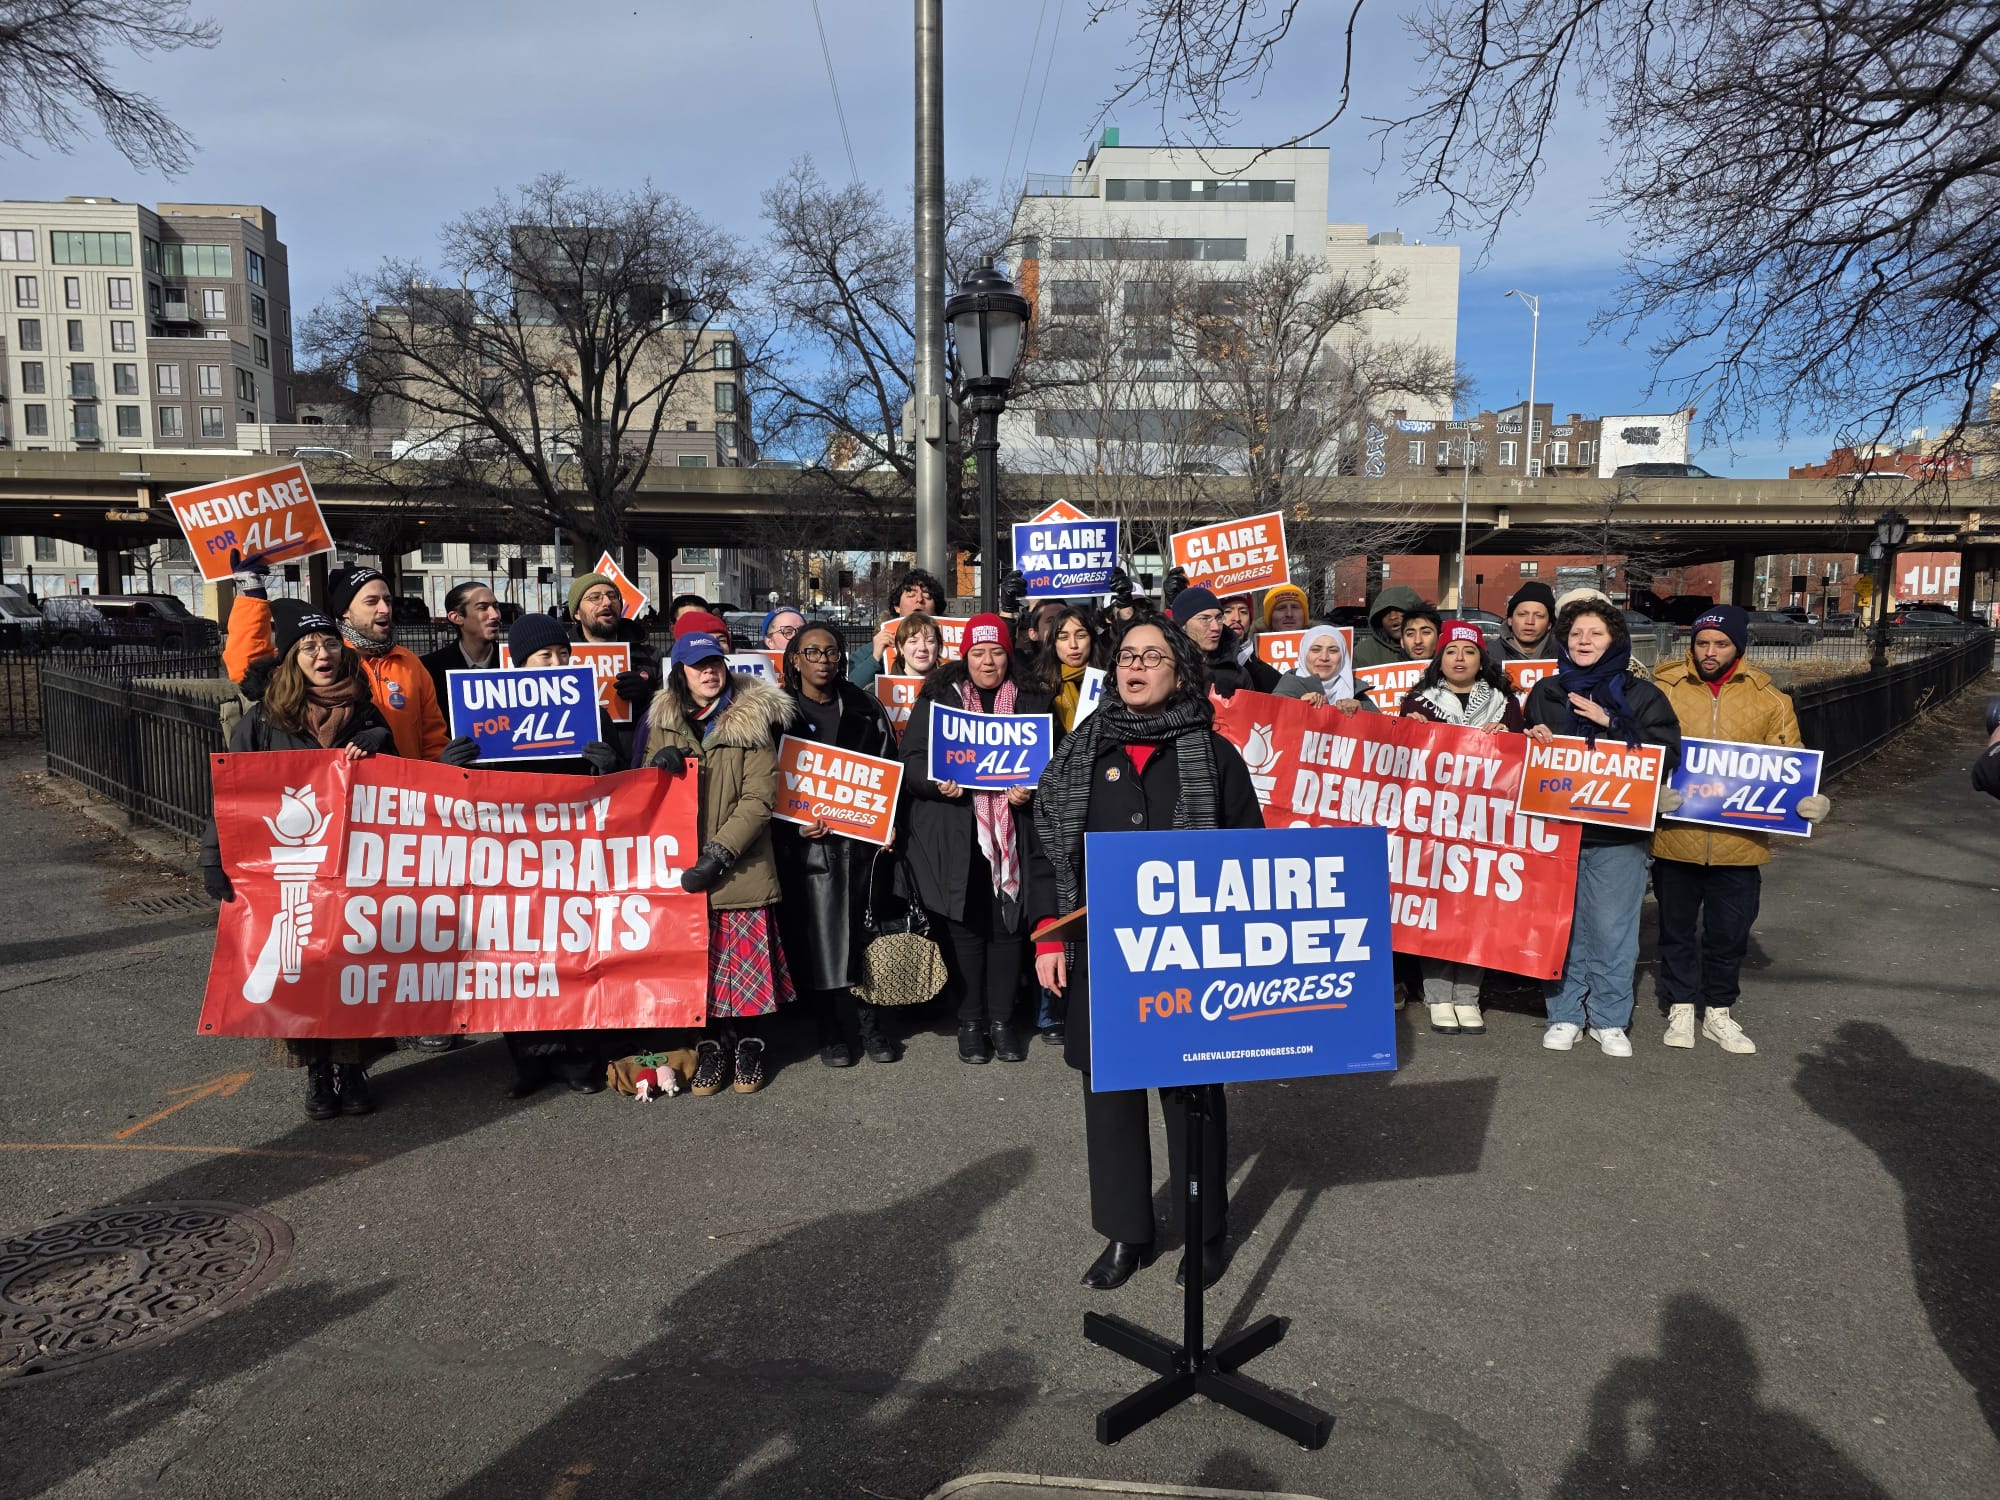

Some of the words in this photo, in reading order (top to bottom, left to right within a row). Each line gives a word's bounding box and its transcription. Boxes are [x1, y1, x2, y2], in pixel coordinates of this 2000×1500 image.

[179, 478, 308, 531] MEDICARE
[206, 530, 238, 554] FOR
[243, 512, 303, 555] ALL
[1030, 529, 1106, 551] CLAIRE
[1187, 524, 1267, 558] CLAIRE
[1022, 552, 1112, 571] VALDEZ
[1181, 545, 1279, 578] VALDEZ
[1215, 564, 1273, 589] CONGRESS
[1030, 576, 1050, 588] FOR
[1053, 571, 1107, 588] CONGRESS
[1905, 566, 1960, 595] 1UP
[463, 675, 580, 710] UNIONS
[1361, 670, 1424, 690] CLAIR
[473, 716, 510, 738] FOR
[512, 710, 575, 742] ALL
[943, 714, 1037, 746] UNIONS
[797, 750, 884, 790] CLAIRE
[946, 749, 976, 764] FOR
[976, 749, 1030, 774] ALL
[1300, 730, 1357, 770] NEW
[1362, 741, 1430, 781] YORK
[1434, 752, 1502, 789] CITY
[1530, 746, 1656, 781] MEDICARE
[1686, 747, 1802, 784] UNIONS
[351, 784, 426, 826] NEW
[434, 794, 527, 833] YORK
[534, 796, 611, 832] CITY
[785, 771, 888, 813] VALDEZ
[1539, 777, 1573, 792] FOR
[1570, 780, 1632, 808] ALL
[1687, 782, 1725, 798] FOR
[1722, 785, 1787, 814] ALL
[788, 800, 809, 811] FOR
[812, 802, 878, 824] CONGRESS
[1292, 769, 1560, 852] DEMOCRATIC
[345, 831, 684, 892] DEMOCRATIC
[1387, 834, 1524, 901] ALISTS
[1136, 856, 1345, 916] CLAIRE
[343, 895, 650, 955] SOCIALISTS
[1114, 918, 1370, 972] VALDEZ
[340, 964, 388, 1005] OF
[395, 962, 560, 1003] AMERICA
[1139, 988, 1192, 1022] FOR
[1200, 972, 1356, 1021] CONGRESS
[1183, 1046, 1314, 1062] CLAIREVALDEZFORCONGRESS.COM
